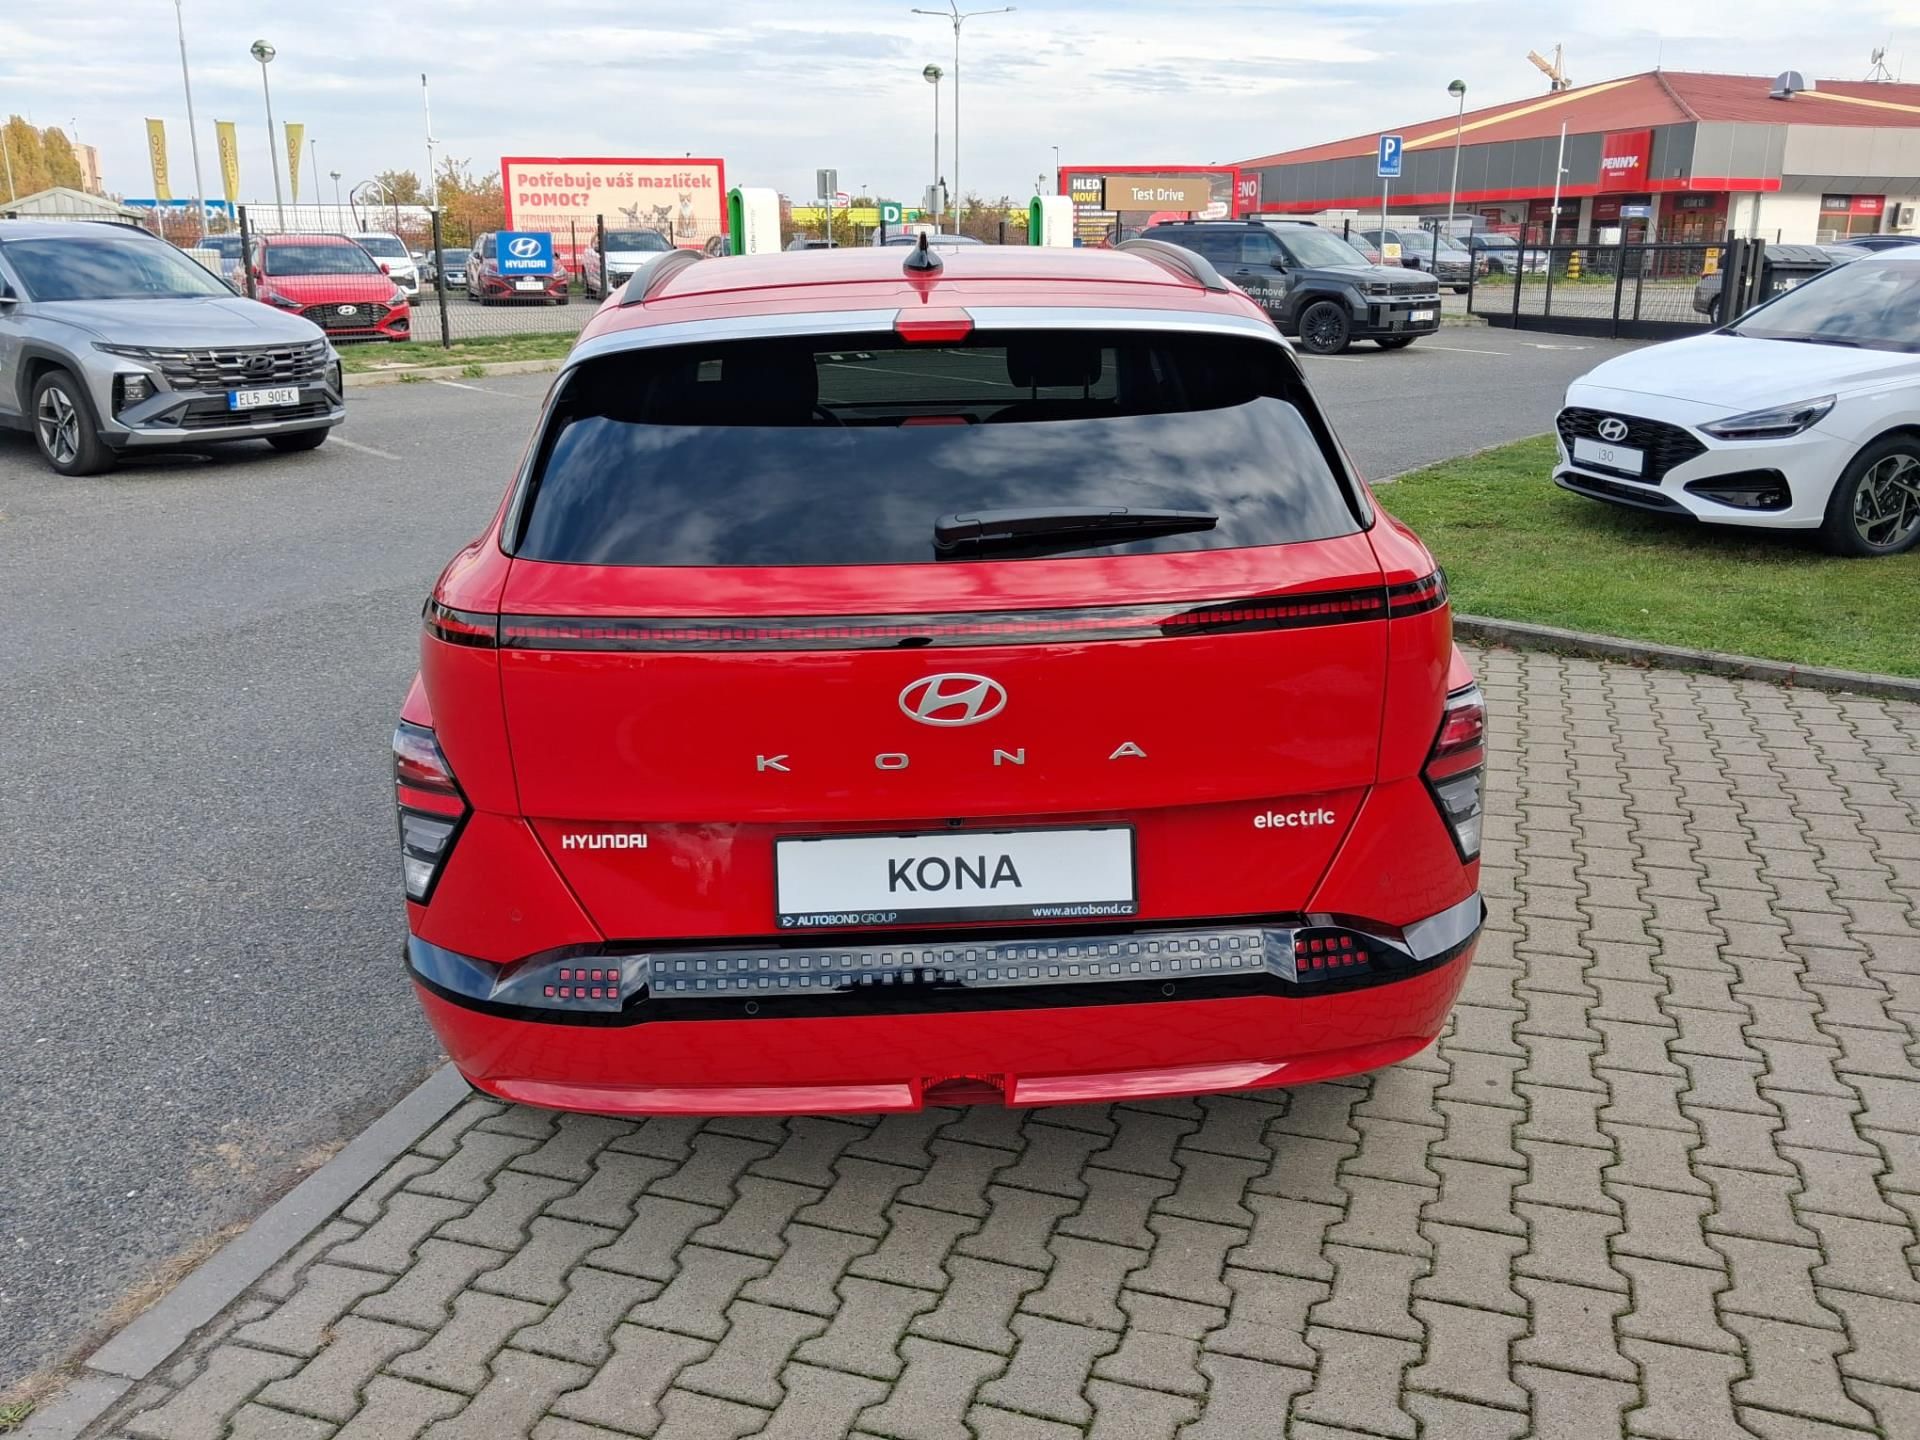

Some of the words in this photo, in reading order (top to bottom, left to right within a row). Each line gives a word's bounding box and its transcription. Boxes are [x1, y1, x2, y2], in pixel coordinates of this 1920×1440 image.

[1385, 139, 1395, 161] P
[517, 172, 602, 190] Potřebuje
[606, 173, 634, 188] váš
[638, 173, 712, 188] mazlíček
[1073, 178, 1102, 190] HLED
[519, 193, 590, 207] POMOC?
[1073, 190, 1097, 202] NOVÉ
[1131, 188, 1155, 201] Test
[1157, 188, 1184, 201] Drive
[884, 206, 899, 222] D
[505, 259, 546, 268] HYUNDAI
[1262, 286, 1284, 297] nové
[240, 391, 259, 405] EL5
[268, 389, 294, 402] 90EK
[1598, 447, 1614, 462] i30
[756, 741, 1147, 772] KONA
[1253, 808, 1335, 828] electric
[562, 833, 648, 849] HYUNDAI
[888, 854, 1023, 893] KONA
[1032, 904, 1133, 917] www.autobond.cz
[796, 913, 859, 926] AUTOBOND
[861, 912, 897, 924] GROUP
